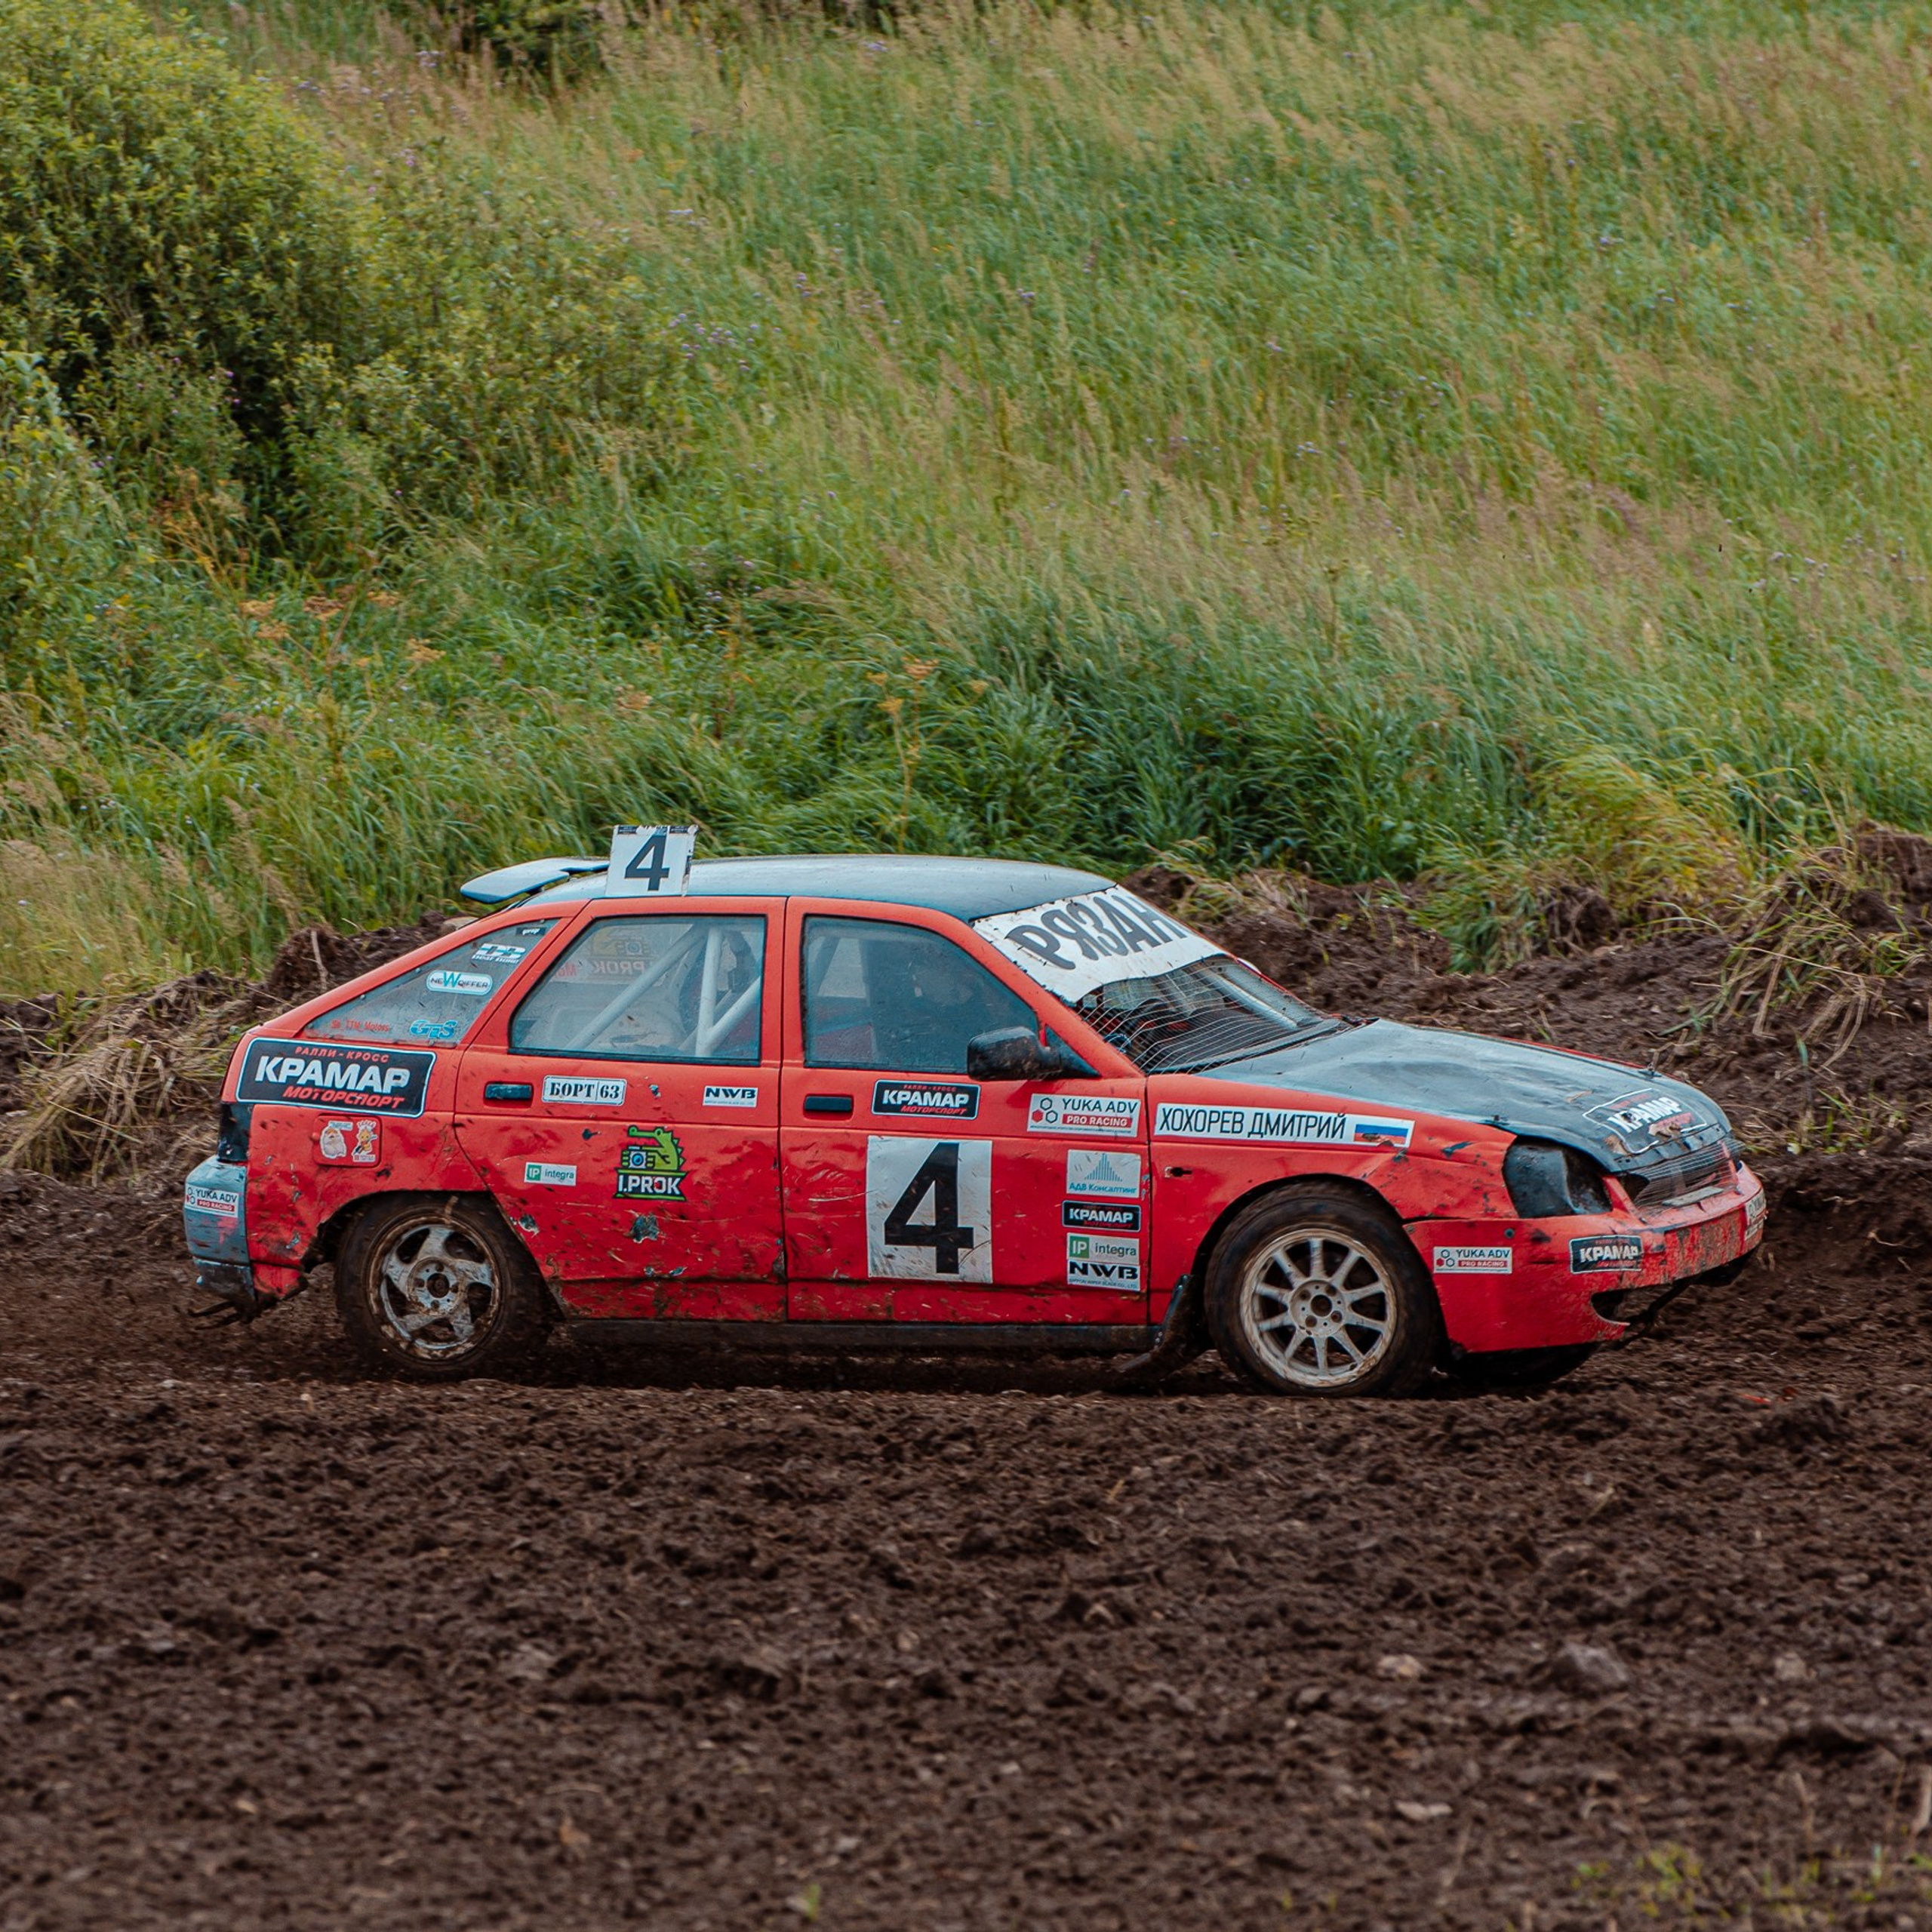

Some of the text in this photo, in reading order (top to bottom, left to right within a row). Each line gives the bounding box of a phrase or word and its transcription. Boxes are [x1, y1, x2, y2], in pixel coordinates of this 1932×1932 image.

[624, 826, 670, 891] 4
[1004, 894, 1191, 971] РЯЗАН
[295, 1046, 336, 1058] РАЛЛИ
[346, 1051, 389, 1063] КРОСС
[255, 1056, 411, 1094] КРАМАР
[282, 1085, 405, 1109] МОТОРСПОРТ
[549, 1081, 620, 1100] БОРТ 63
[706, 1088, 756, 1099] NWB
[882, 1090, 970, 1108] КРАМАР
[900, 1105, 967, 1115] МОТОРСПОРТ
[1063, 1098, 1138, 1113] YUKA ADV
[1066, 1115, 1128, 1127] PRO RACING
[1159, 1107, 1346, 1140] ХОХОРЕВ ДМИТРИЙ
[529, 1167, 575, 1180] IP integra
[618, 1174, 681, 1195] I.PROK
[1069, 1182, 1137, 1194] АДВ Консалтинг
[195, 1188, 237, 1203] YUKA ADV
[884, 1142, 974, 1274] 4
[1069, 1208, 1134, 1223] КРАМАР
[1072, 1240, 1137, 1257] IP integra
[1456, 1249, 1510, 1258] YUKA ADV
[1580, 1245, 1638, 1263] КРАМАР
[1069, 1261, 1138, 1280] NWB
